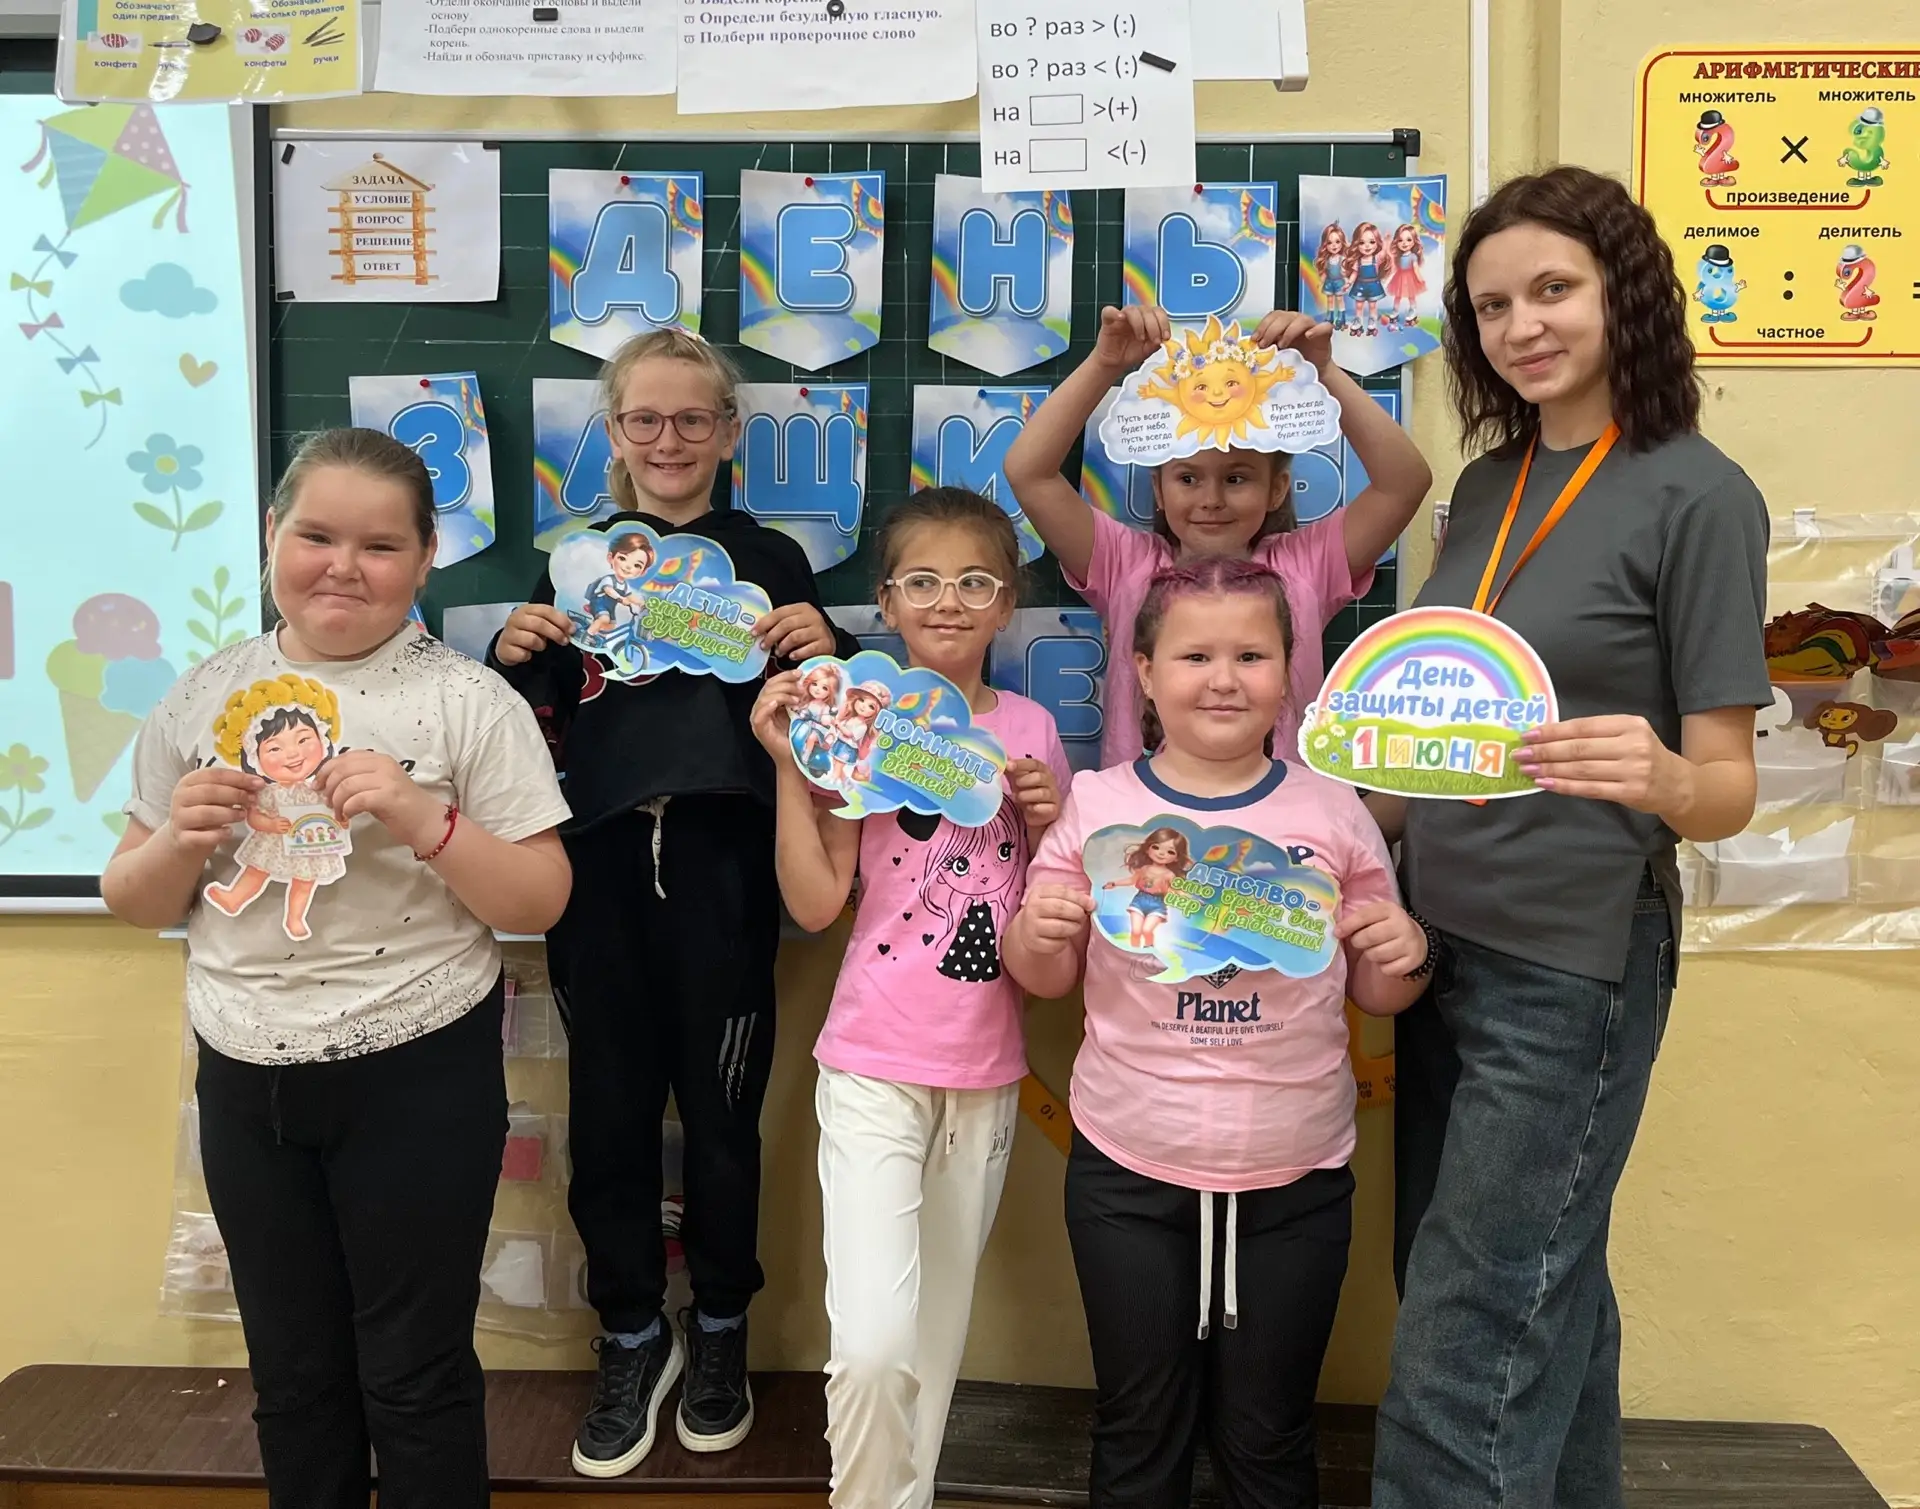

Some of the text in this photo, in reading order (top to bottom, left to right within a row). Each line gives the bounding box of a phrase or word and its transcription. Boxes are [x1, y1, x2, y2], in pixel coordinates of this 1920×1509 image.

[700, 9, 942, 26] Определи безударную гласную.
[479, 25, 558, 35] однокоренные
[561, 26, 591, 34] слова
[604, 26, 644, 35] выдели
[990, 23, 1018, 37] во
[1045, 20, 1085, 39] раз
[700, 29, 916, 44] Подбери проверочное слово
[94, 60, 138, 69] конфета
[244, 60, 288, 68] конфеты
[313, 55, 340, 65] ручки
[475, 52, 525, 61] обозначь
[527, 53, 582, 64] приставку
[992, 65, 1019, 79] во
[1047, 62, 1086, 81] раз
[1679, 91, 1776, 103] множитель
[1818, 89, 1916, 102] множитель
[993, 107, 1020, 122] на
[994, 150, 1021, 166] на
[352, 175, 404, 186] ЗАДАЧА
[354, 195, 411, 204] УСЛОВИЕ
[1726, 191, 1850, 206] произведение
[357, 215, 405, 224] ВОПРОС
[1684, 226, 1760, 239] делимое
[1818, 226, 1902, 239] делитель
[356, 237, 414, 246] РЕШЕНИЕ
[363, 262, 401, 271] ОТВЕТ
[1757, 327, 1825, 339] частное
[1272, 400, 1324, 412] Пусть всегда
[1117, 412, 1171, 424] Пусть всегда
[1270, 414, 1292, 422] будет
[1299, 420, 1325, 428] всегда
[1121, 425, 1143, 435] будет
[1278, 431, 1300, 440] будет
[1122, 433, 1172, 445] пусть всегда
[1128, 445, 1150, 454] будет
[645, 597, 755, 646] это наше
[641, 611, 750, 664] будущее!
[1397, 659, 1475, 690] День
[1328, 691, 1546, 723] защиты детей
[873, 708, 998, 784] ПОМНИТЕ
[1355, 728, 1375, 766] 1
[877, 733, 976, 790] о правах
[882, 752, 959, 800] детей!
[1170, 876, 1327, 934] это время для
[1164, 891, 1326, 952] игр и радости!
[1176, 991, 1261, 1023] Planet
[1162, 1022, 1188, 1033] DESERVE
[1225, 1026, 1239, 1035] LIFE
[1240, 1026, 1254, 1034] GIVE
[1256, 1022, 1284, 1033] YOURSELF
[1190, 1037, 1243, 1046] SOME SELF LOVE
